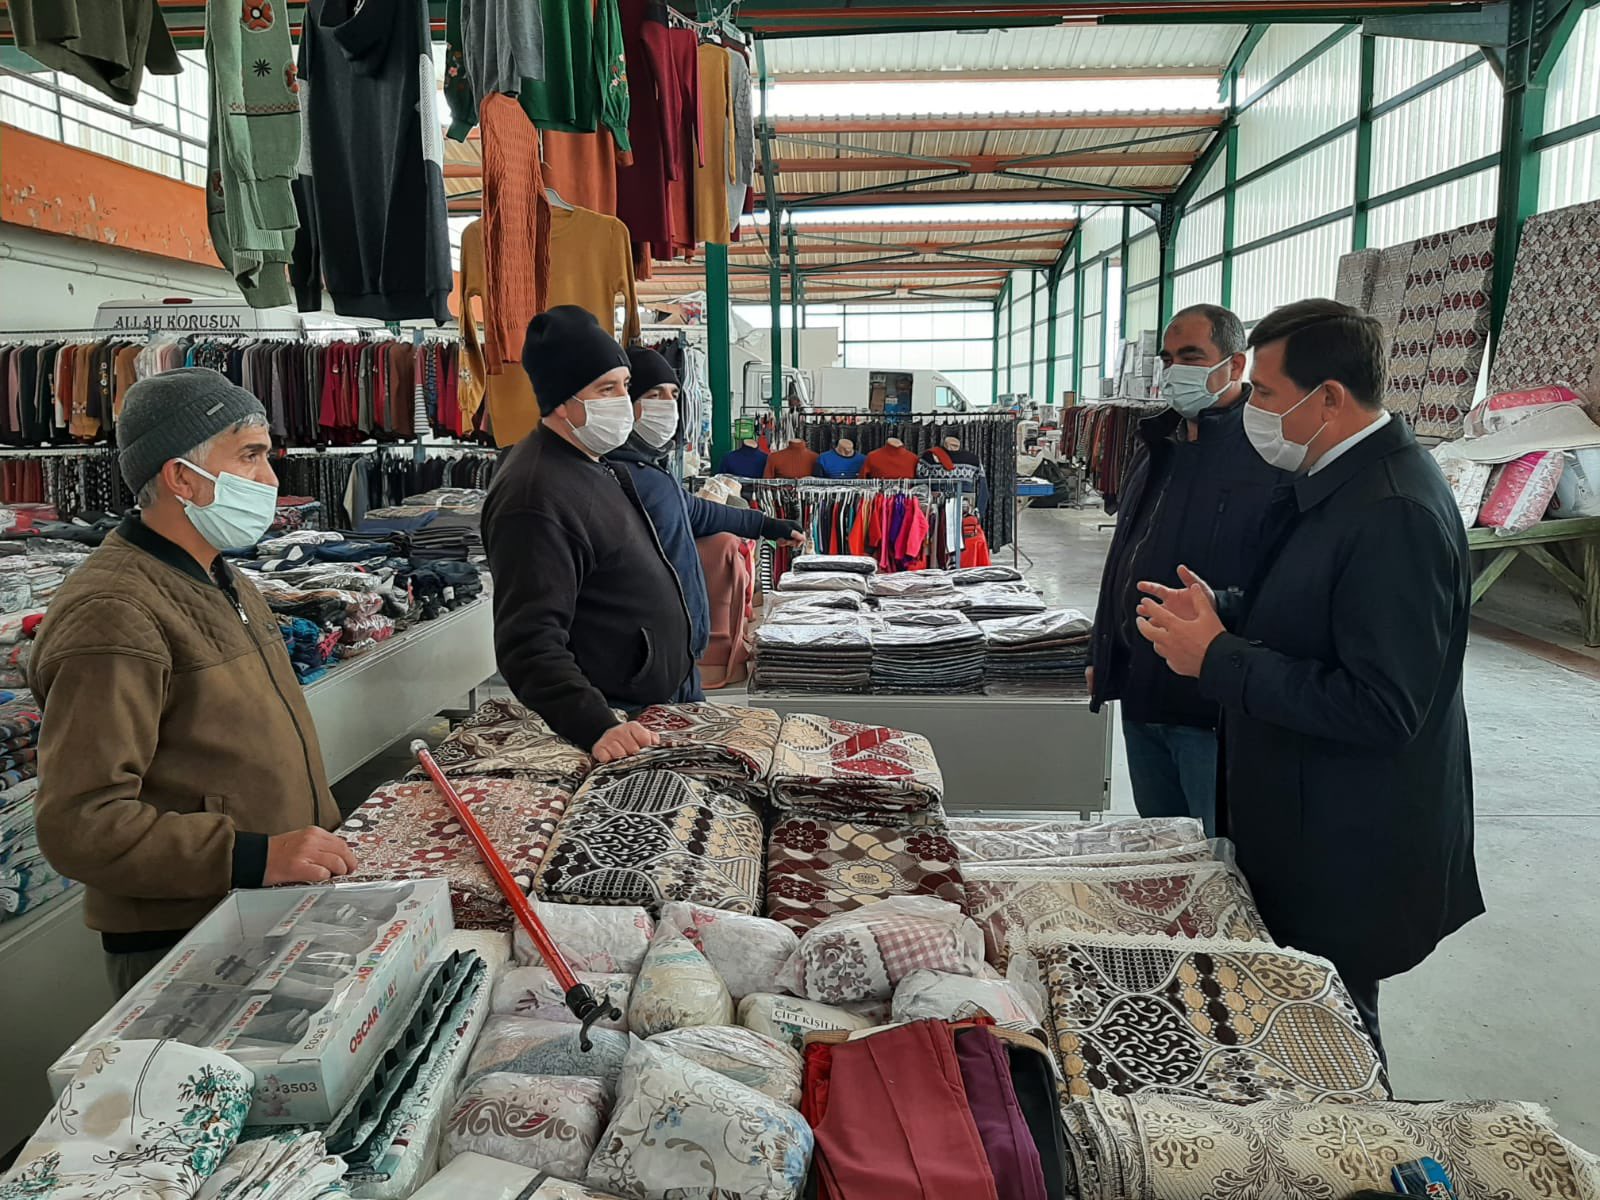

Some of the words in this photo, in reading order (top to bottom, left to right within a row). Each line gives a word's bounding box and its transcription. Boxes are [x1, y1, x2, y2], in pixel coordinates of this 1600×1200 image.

[114, 315, 161, 329] ALLAH
[167, 314, 240, 329] KORUSUN
[281, 1081, 318, 1094] 3503
